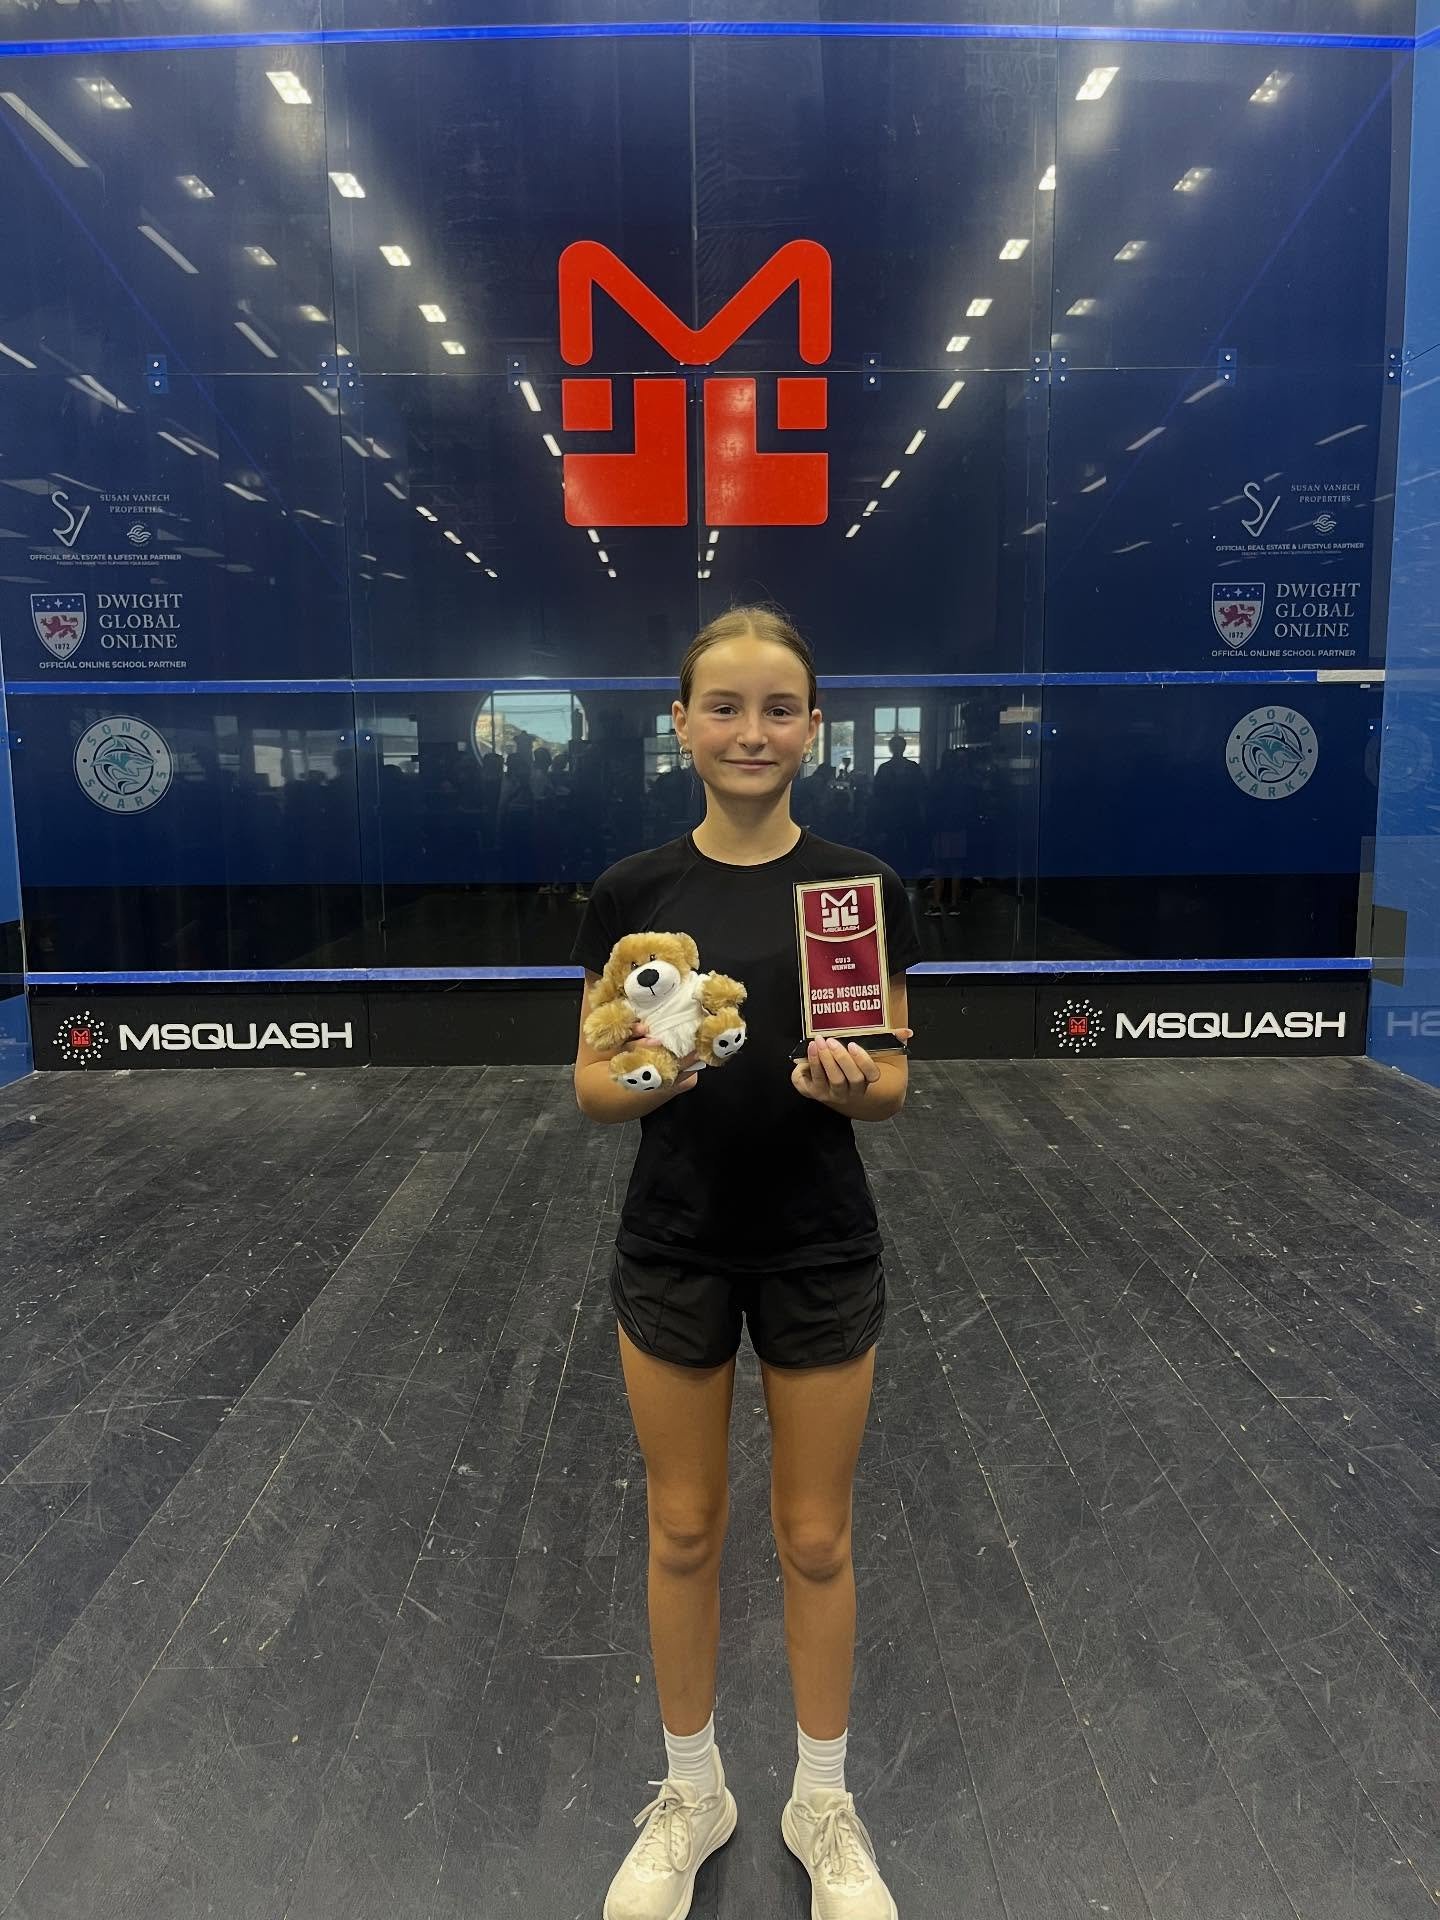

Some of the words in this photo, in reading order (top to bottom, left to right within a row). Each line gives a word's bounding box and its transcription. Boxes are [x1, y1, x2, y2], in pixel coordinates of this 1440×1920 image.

[1290, 484, 1321, 492] SUSAN
[1323, 483, 1361, 491] VANECH
[99, 494, 130, 502] SUSAN
[132, 494, 171, 502] VANECH
[1299, 495, 1352, 503] PROPERTIES
[109, 506, 164, 514] PROPERTIES
[1266, 543, 1290, 551] ESTATE
[1276, 583, 1361, 598] DWIGHT
[97, 593, 183, 609] DWIGHT
[1275, 603, 1355, 618] GLOBAL
[99, 614, 181, 629] GLOBAL
[1274, 623, 1350, 638] ONLINE
[100, 634, 178, 649] ONLINE
[1317, 649, 1356, 657] PARTNER
[39, 661, 77, 669] OFFICIAL
[78, 661, 111, 669] ONLINE
[112, 661, 147, 669] SCHOOL
[1248, 708, 1310, 737] SONO
[87, 721, 151, 746] SONO
[1229, 755, 1309, 798] SHARKS
[84, 771, 167, 809] SHARKS
[831, 963, 856, 971] WINNER
[811, 988, 835, 1001] 2025
[836, 984, 880, 999] MSQUASH
[812, 1001, 850, 1015] JUNIOR
[853, 999, 881, 1012] GOLD
[1115, 1011, 1346, 1039] MSQUASH
[118, 1022, 353, 1051] MSQUASH
